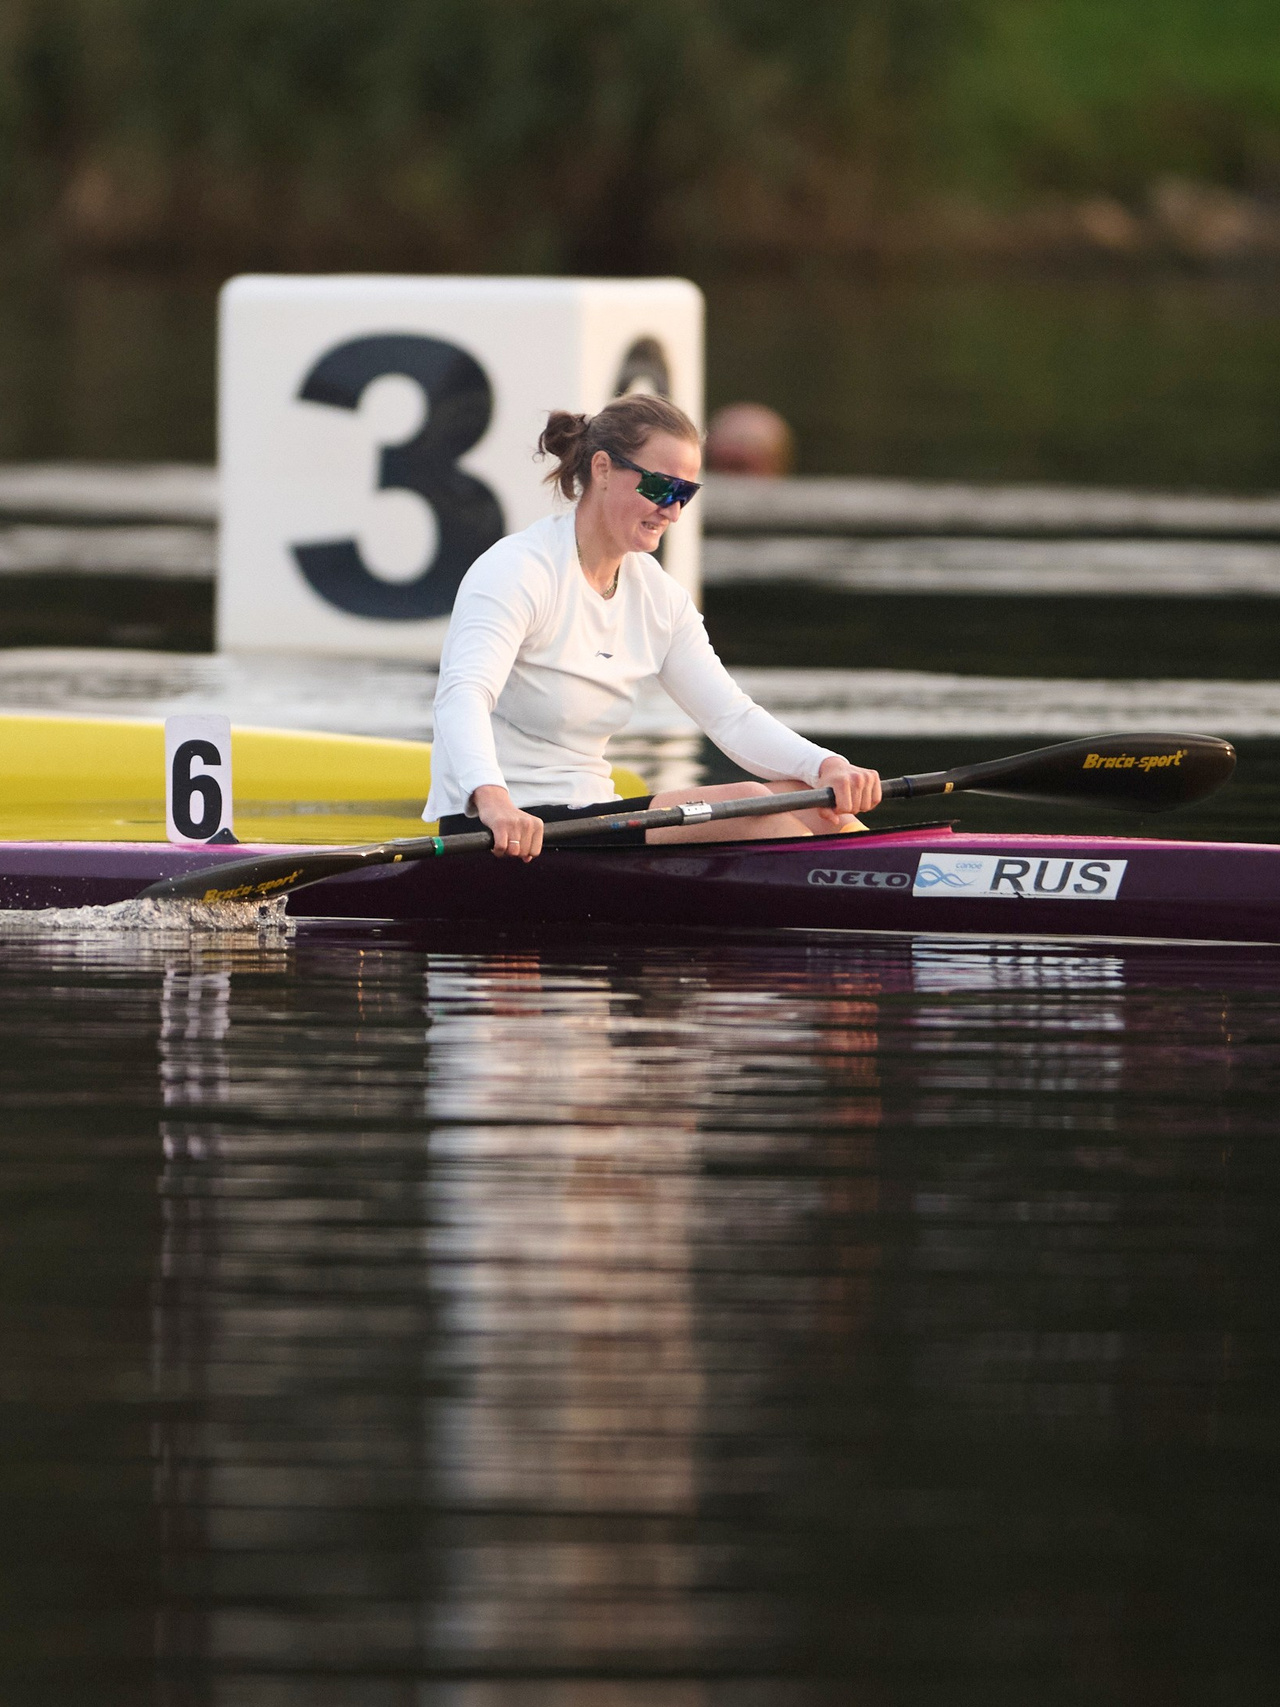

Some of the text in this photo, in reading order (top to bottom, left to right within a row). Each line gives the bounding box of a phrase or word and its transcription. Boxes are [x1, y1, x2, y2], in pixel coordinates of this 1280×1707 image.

[292, 332, 507, 623] 3
[172, 739, 222, 839] 6
[811, 870, 908, 888] NELO
[989, 858, 1111, 894] RUS
